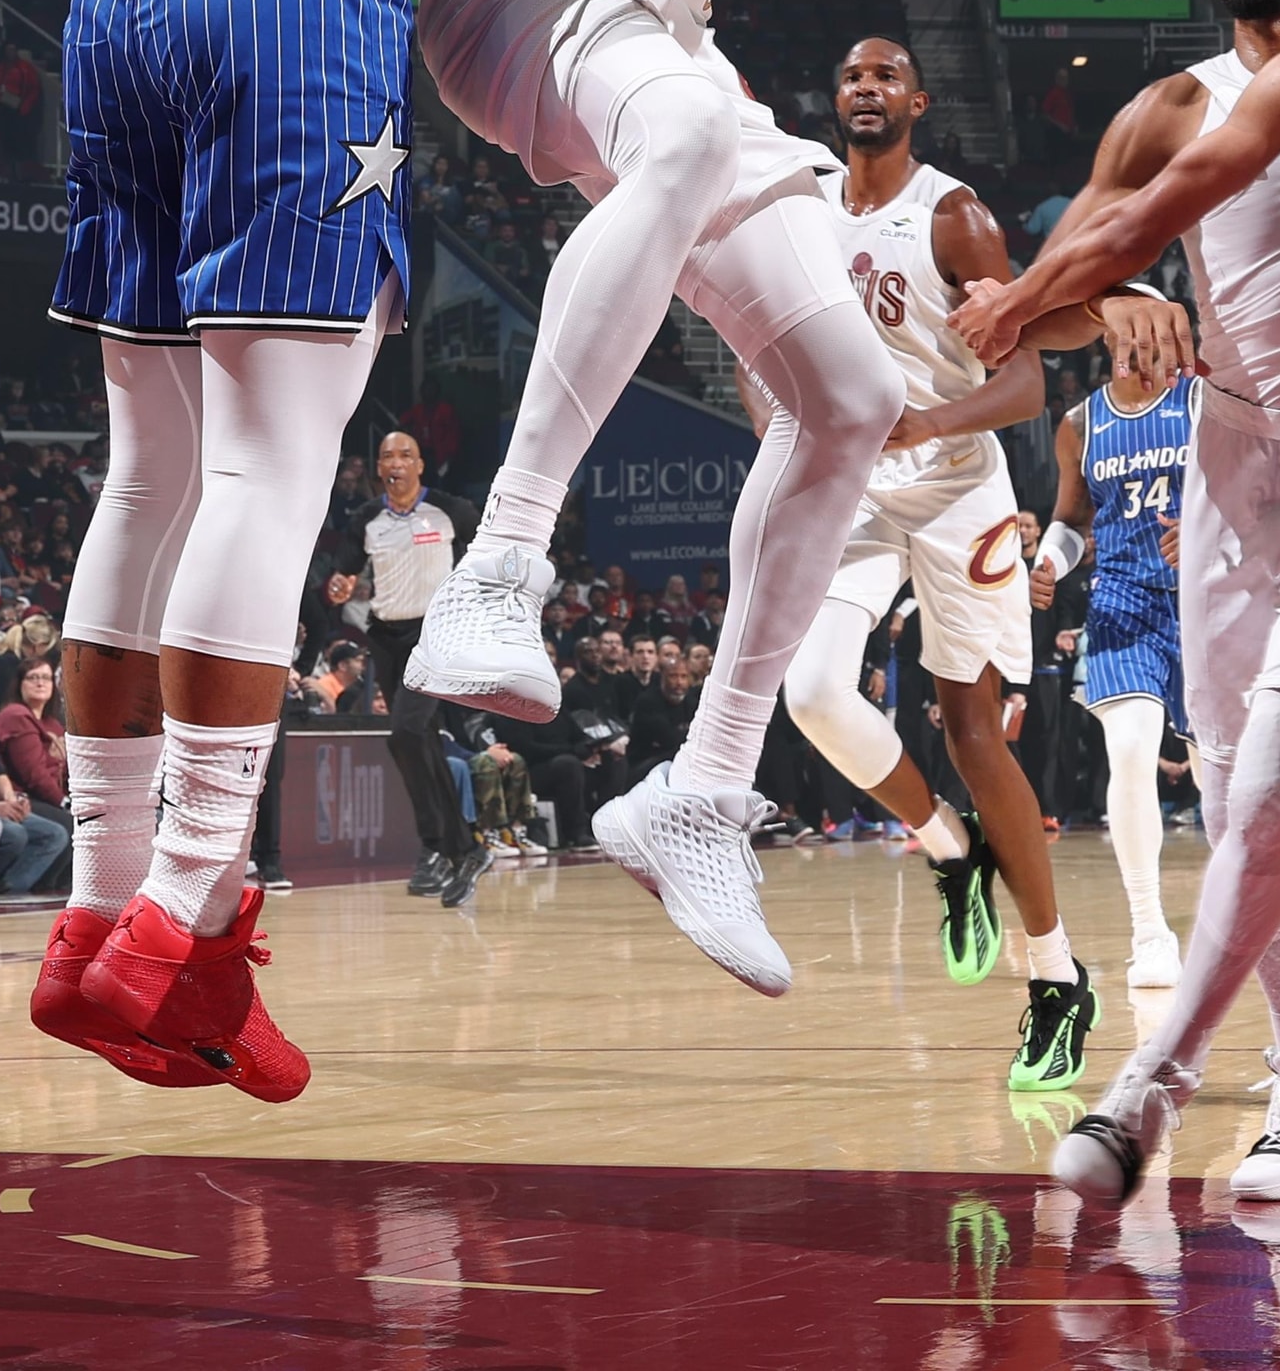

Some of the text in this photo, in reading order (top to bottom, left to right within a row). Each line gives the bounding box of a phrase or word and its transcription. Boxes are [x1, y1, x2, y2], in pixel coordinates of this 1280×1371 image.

[880, 228, 917, 242] CLIFFS
[1123, 475, 1170, 519] 34
[338, 746, 384, 858] App
